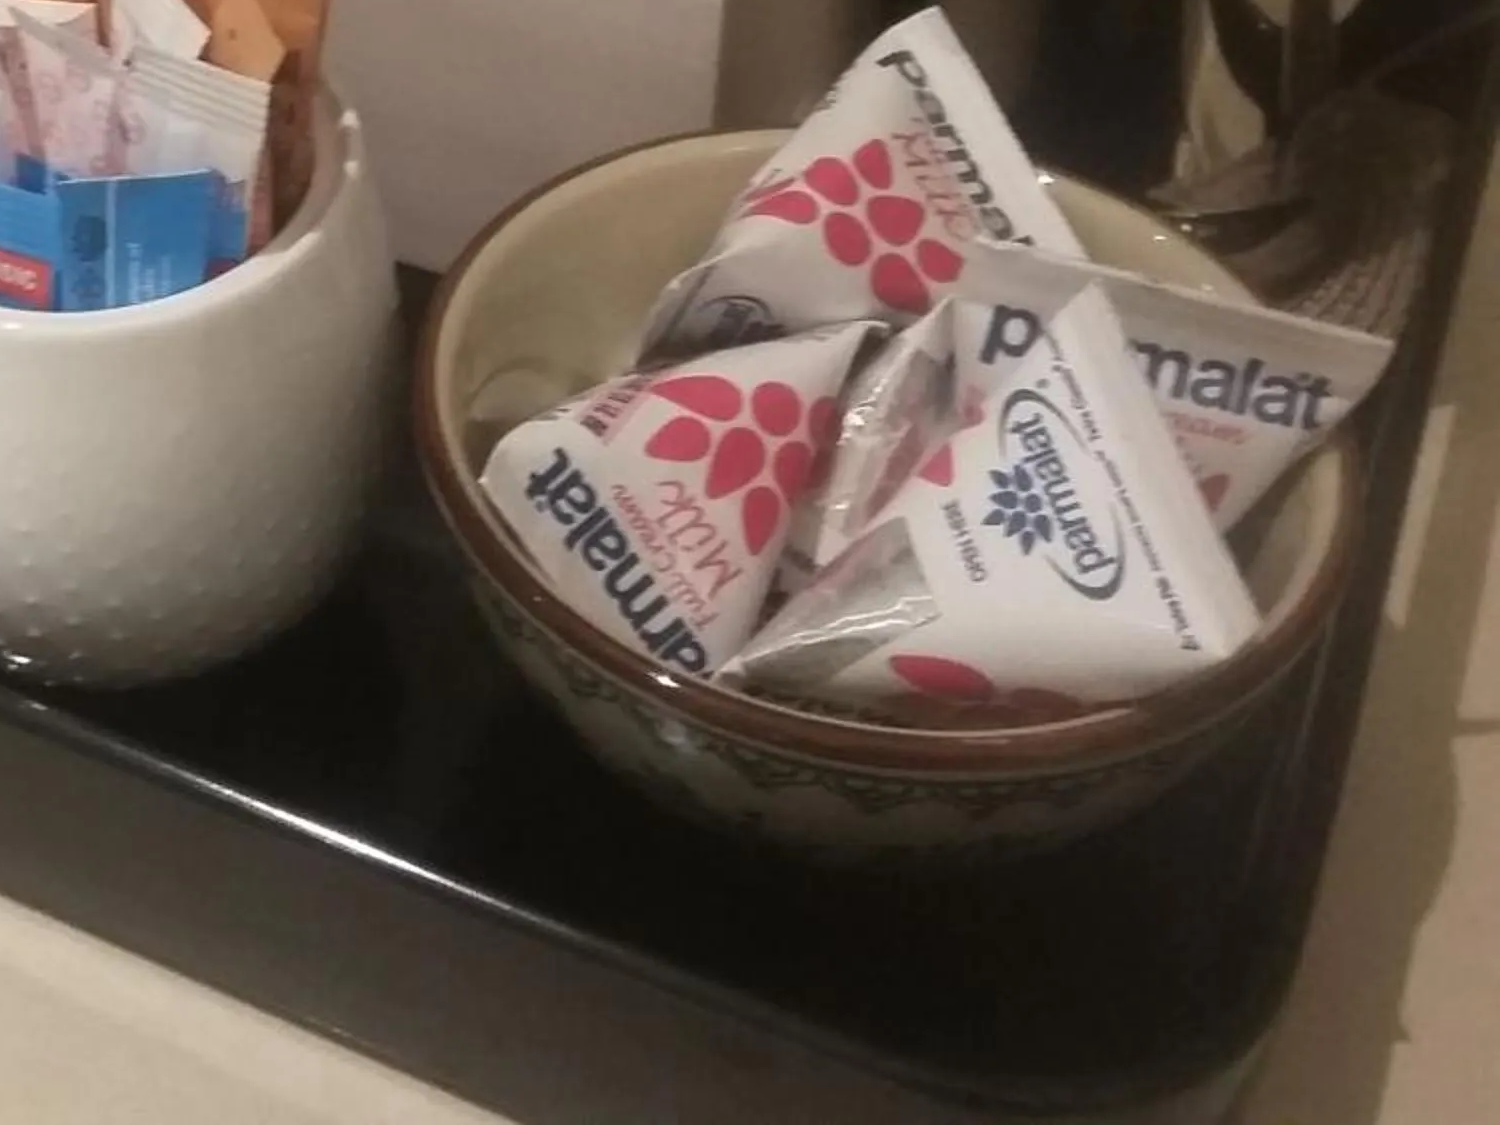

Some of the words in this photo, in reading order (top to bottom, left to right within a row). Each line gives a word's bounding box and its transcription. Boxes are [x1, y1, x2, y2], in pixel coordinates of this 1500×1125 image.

[526, 446, 714, 681] armalat
[654, 479, 744, 601] Milk
[1008, 411, 1118, 575] parmalat
